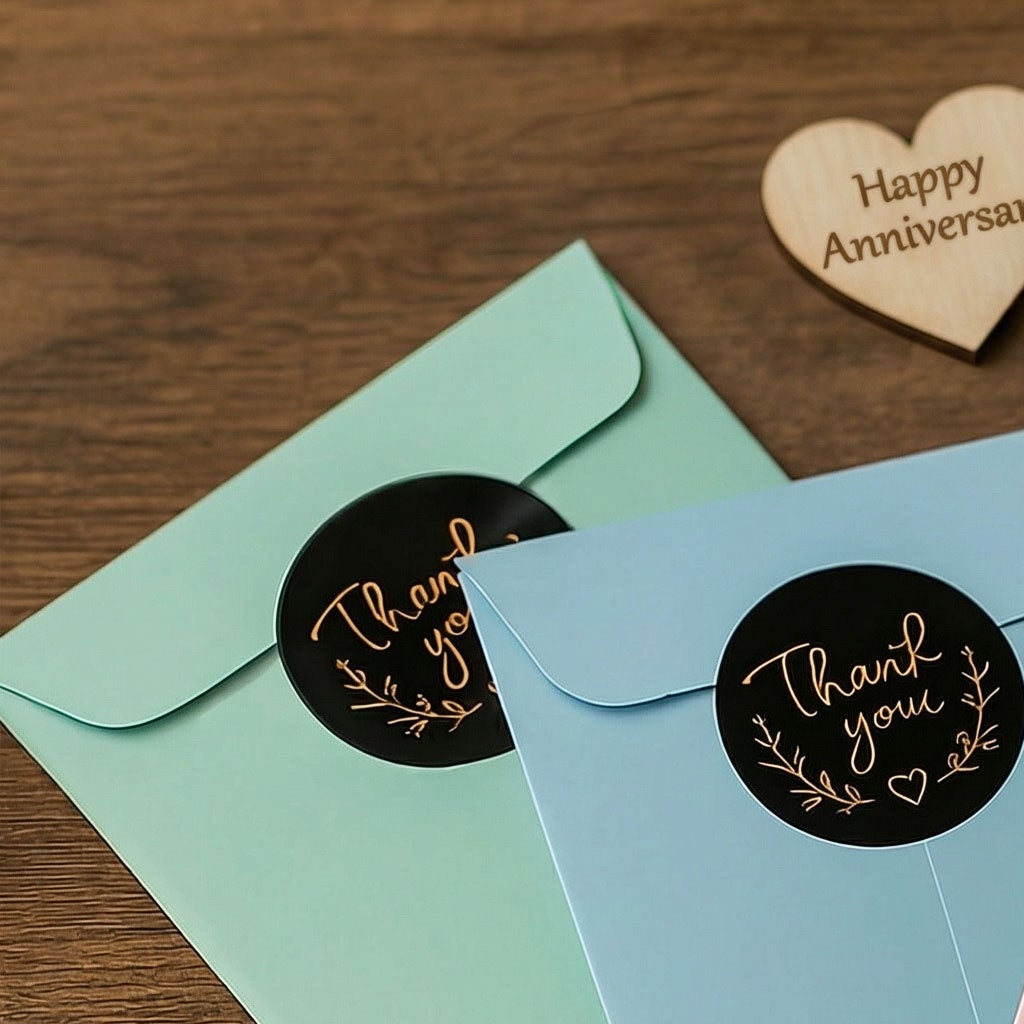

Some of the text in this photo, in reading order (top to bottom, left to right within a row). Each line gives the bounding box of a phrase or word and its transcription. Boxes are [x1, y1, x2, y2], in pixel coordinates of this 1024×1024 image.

[851, 155, 984, 207] Happy
[423, 610, 471, 690] yo
[741, 612, 943, 717] Thank
